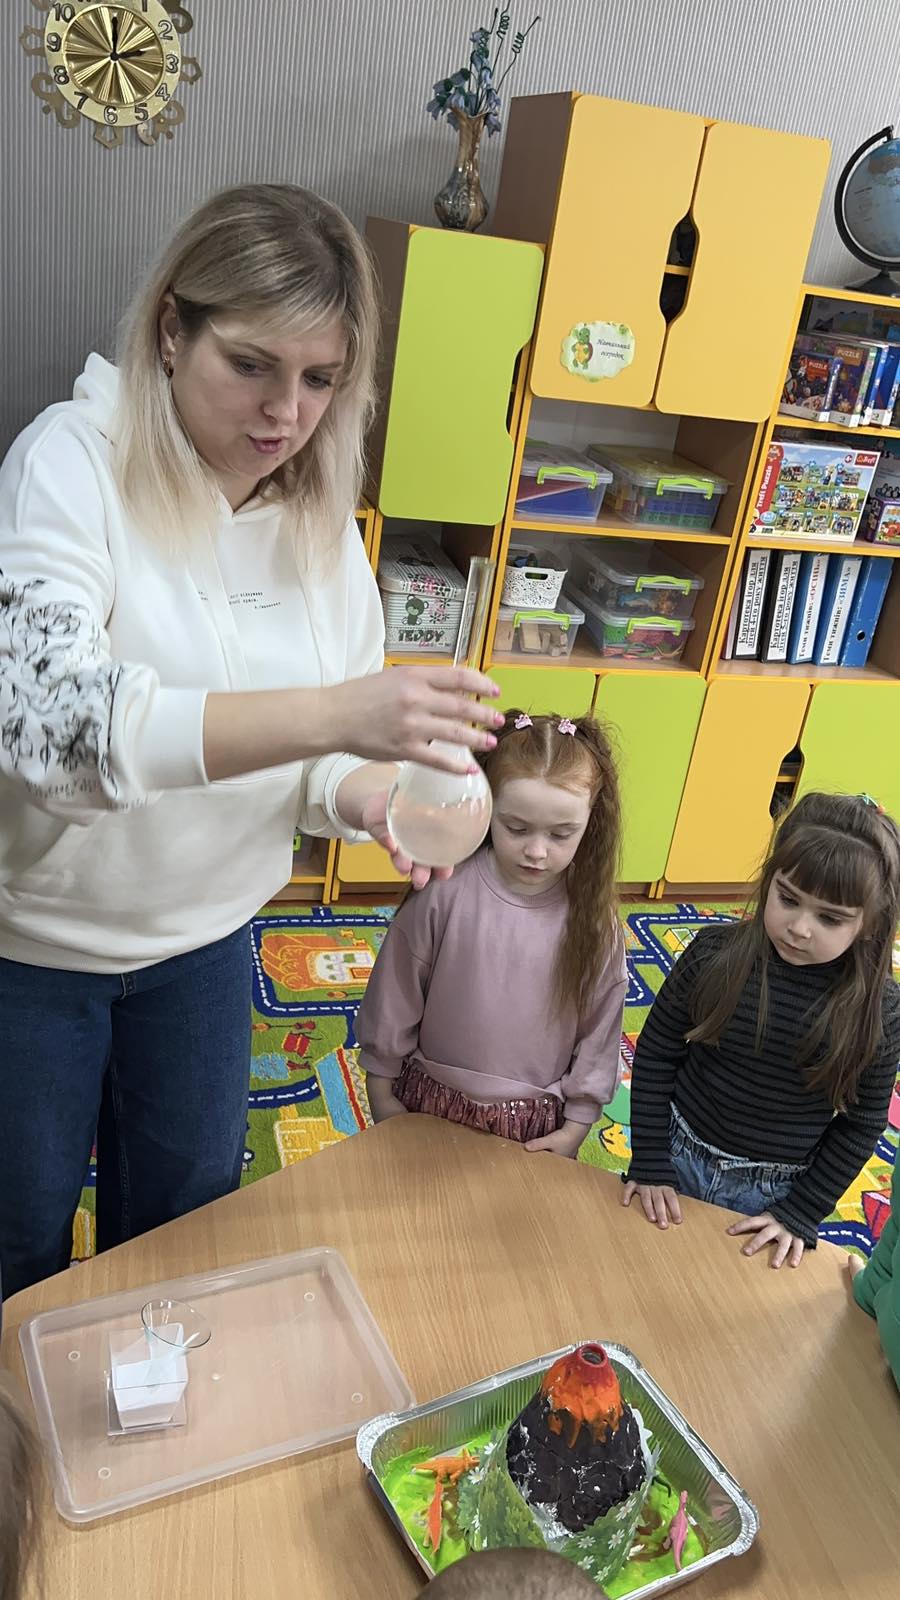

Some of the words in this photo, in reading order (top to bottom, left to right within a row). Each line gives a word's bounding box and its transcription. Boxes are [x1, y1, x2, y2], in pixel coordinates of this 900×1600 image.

[52, 3, 75, 22] 10
[157, 19, 173, 40] 2
[46, 32, 61, 52] 9
[165, 54, 179, 73] 3
[53, 65, 70, 85] 8
[74, 91, 88, 109] 7
[155, 83, 170, 101] 4
[104, 106, 118, 124] 6
[135, 103, 149, 121] 5
[837, 348, 859, 358] PUZZLE
[809, 362, 827, 370] PUZZLE
[757, 556, 766, 584] життя
[789, 560, 798, 589] життя
[754, 586, 762, 606] року
[738, 599, 751, 643] Картотека
[745, 580, 755, 597] ігор
[770, 603, 783, 648] Картотека
[777, 585, 787, 602] ігор
[399, 629, 445, 642] TEDDY
[799, 637, 807, 657] Теми
[824, 641, 833, 660] Теми
